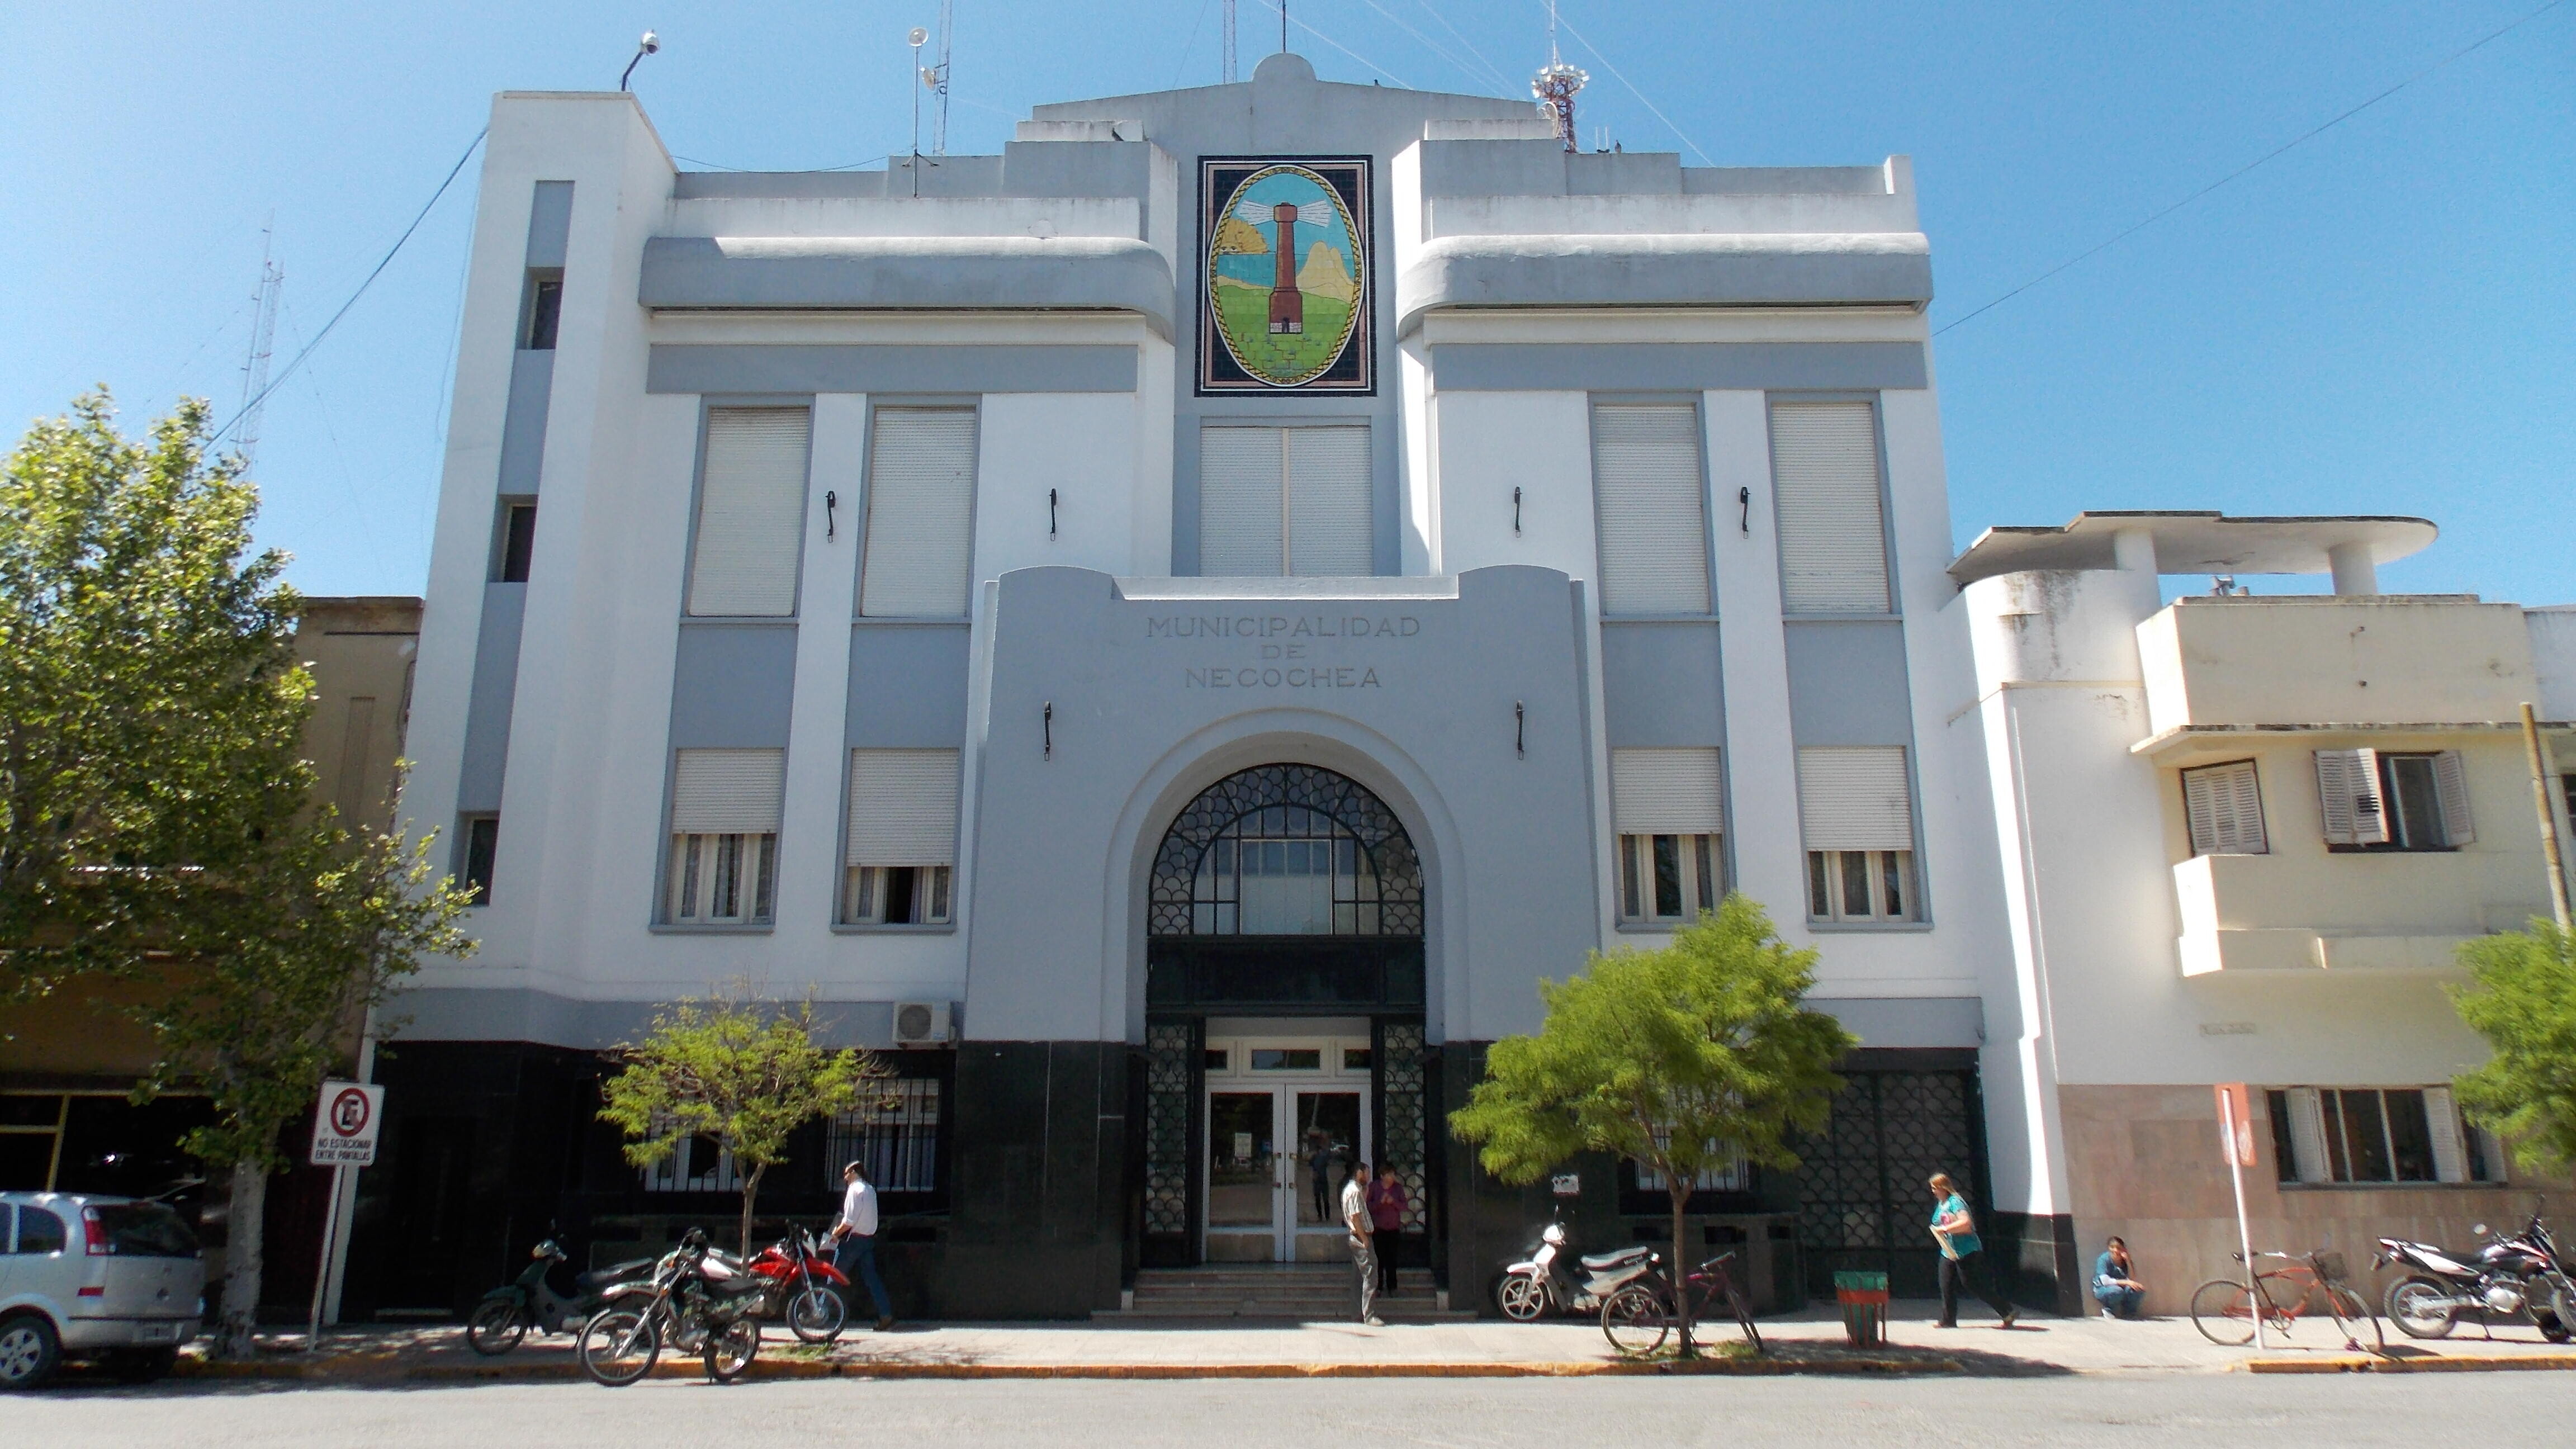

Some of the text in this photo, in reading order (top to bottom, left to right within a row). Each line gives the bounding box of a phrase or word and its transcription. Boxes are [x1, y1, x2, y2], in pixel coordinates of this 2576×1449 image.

[1146, 617, 1420, 638] MUNICIPALIDAD
[1261, 644, 1305, 660] DE
[1185, 667, 1382, 688] NECOCHEA
[317, 1137, 372, 1149] NO ESTACIONAR
[315, 1149, 336, 1160] ENTRE
